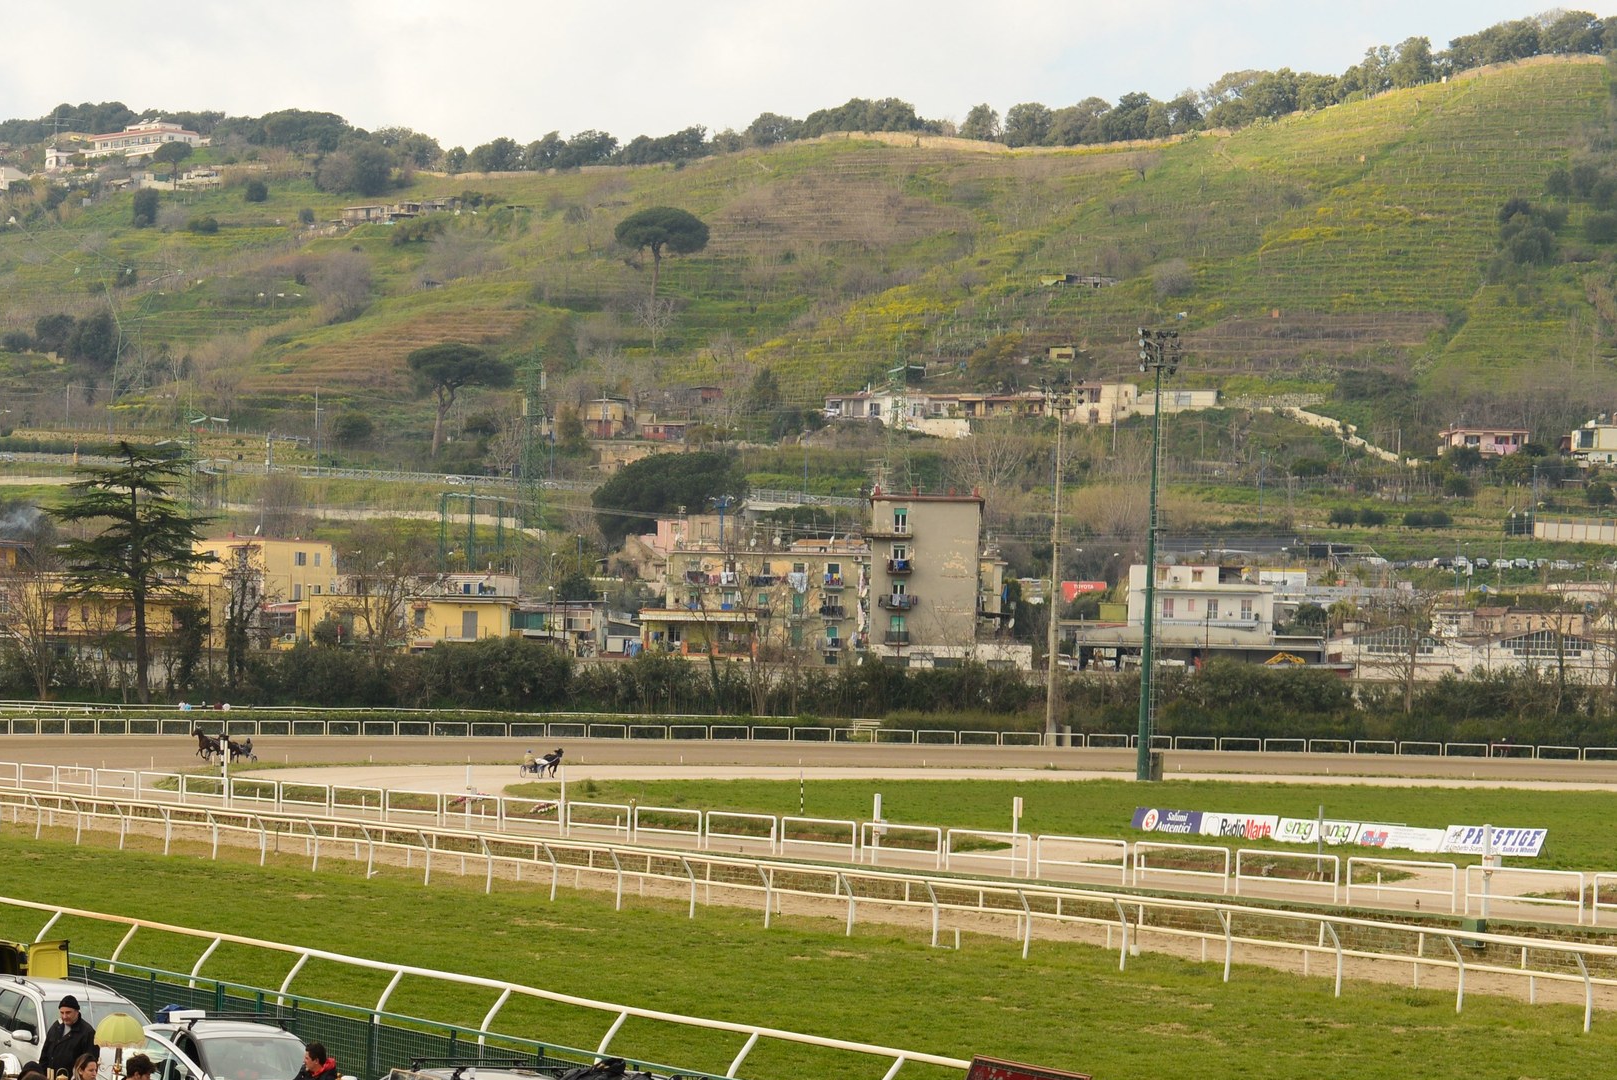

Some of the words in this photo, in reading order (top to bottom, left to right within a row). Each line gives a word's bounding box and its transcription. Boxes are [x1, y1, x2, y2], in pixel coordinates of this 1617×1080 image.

[1166, 810, 1188, 822] Salumi
[1156, 821, 1192, 834] Autentici
[1220, 818, 1271, 840] RadioMarte
